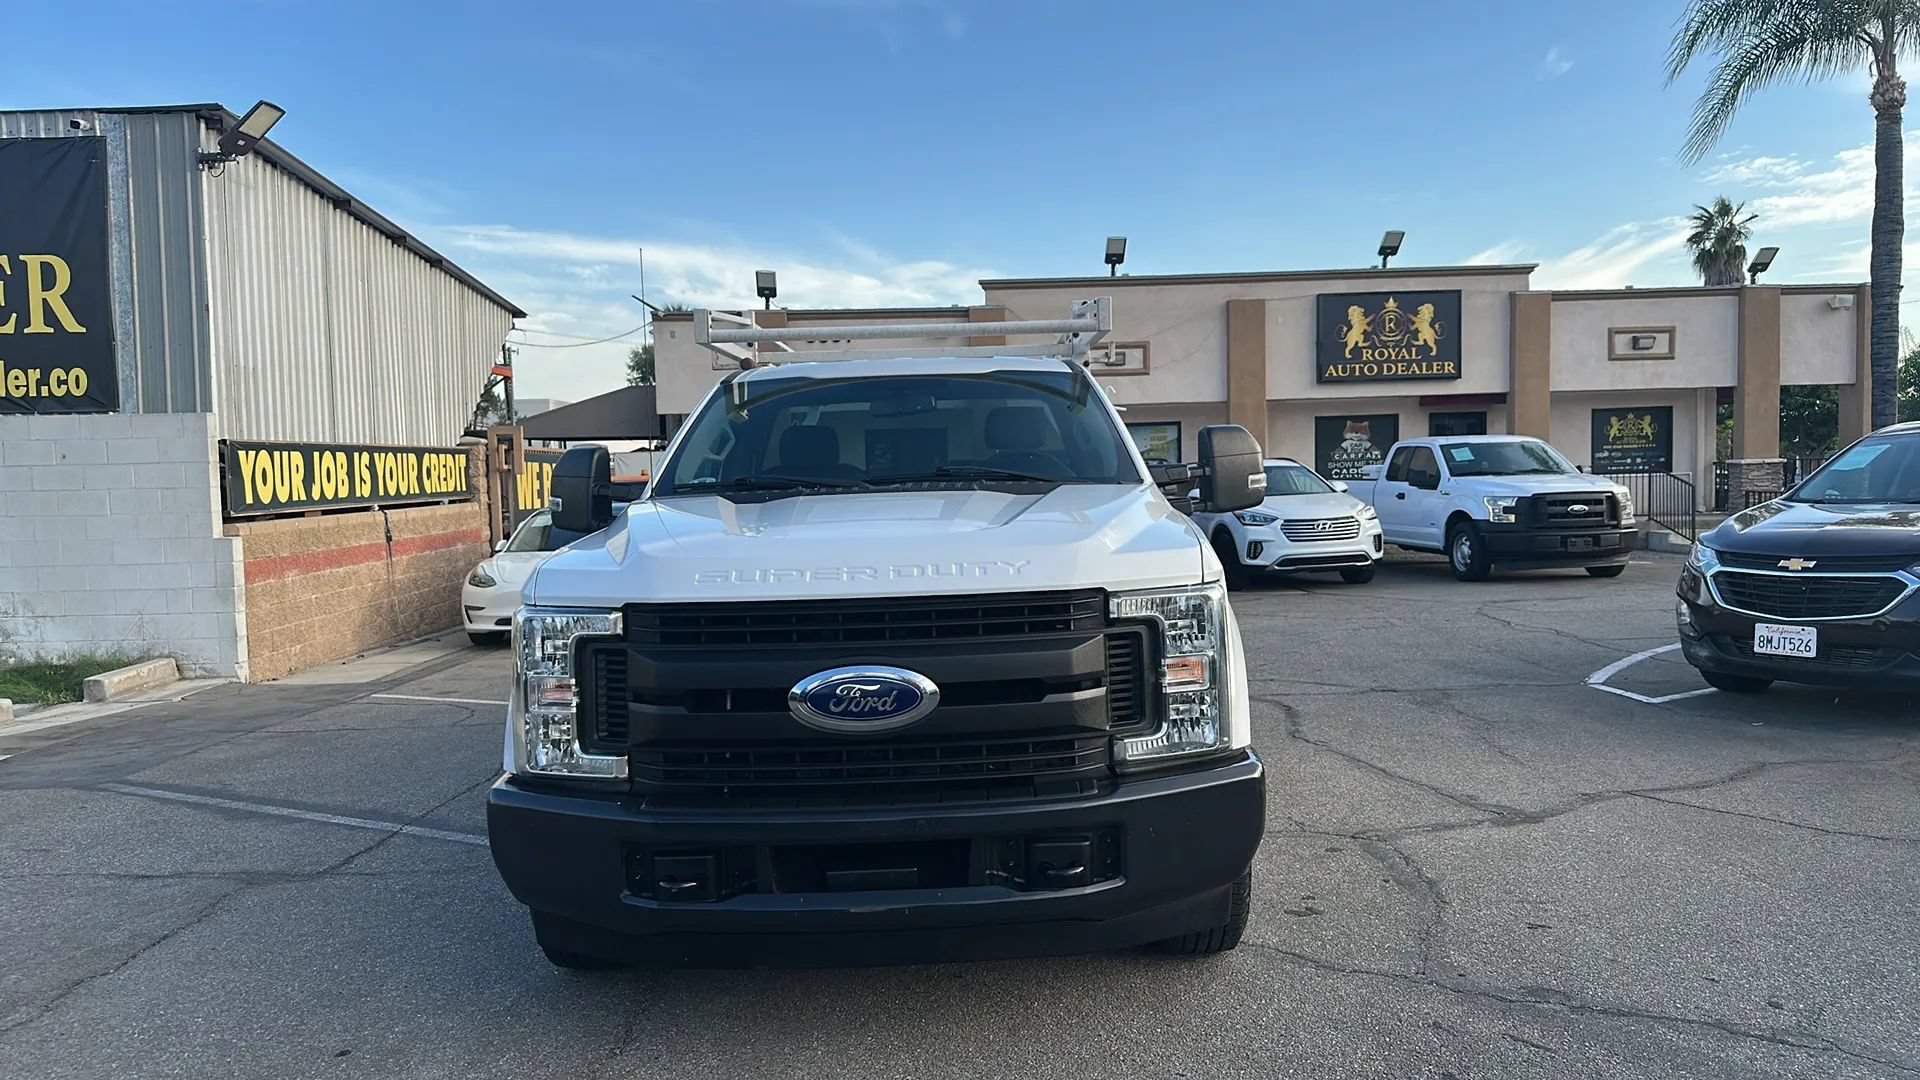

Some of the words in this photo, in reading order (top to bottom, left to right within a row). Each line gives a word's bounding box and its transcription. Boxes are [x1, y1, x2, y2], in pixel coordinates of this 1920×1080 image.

[1361, 347, 1422, 361] ROYAL
[1325, 363, 1378, 377] AUTO
[1382, 361, 1457, 376] DEALER
[238, 449, 307, 505] YOUR
[311, 449, 349, 501] JOB
[354, 451, 372, 498] IS
[374, 451, 421, 497] YOUR
[422, 452, 468, 495] CREDIT
[516, 461, 541, 510] WE
[694, 566, 878, 585] SUPER
[889, 559, 1031, 580] DUTY
[1758, 634, 1812, 653] 8MJT526
[828, 684, 899, 713] Ford
